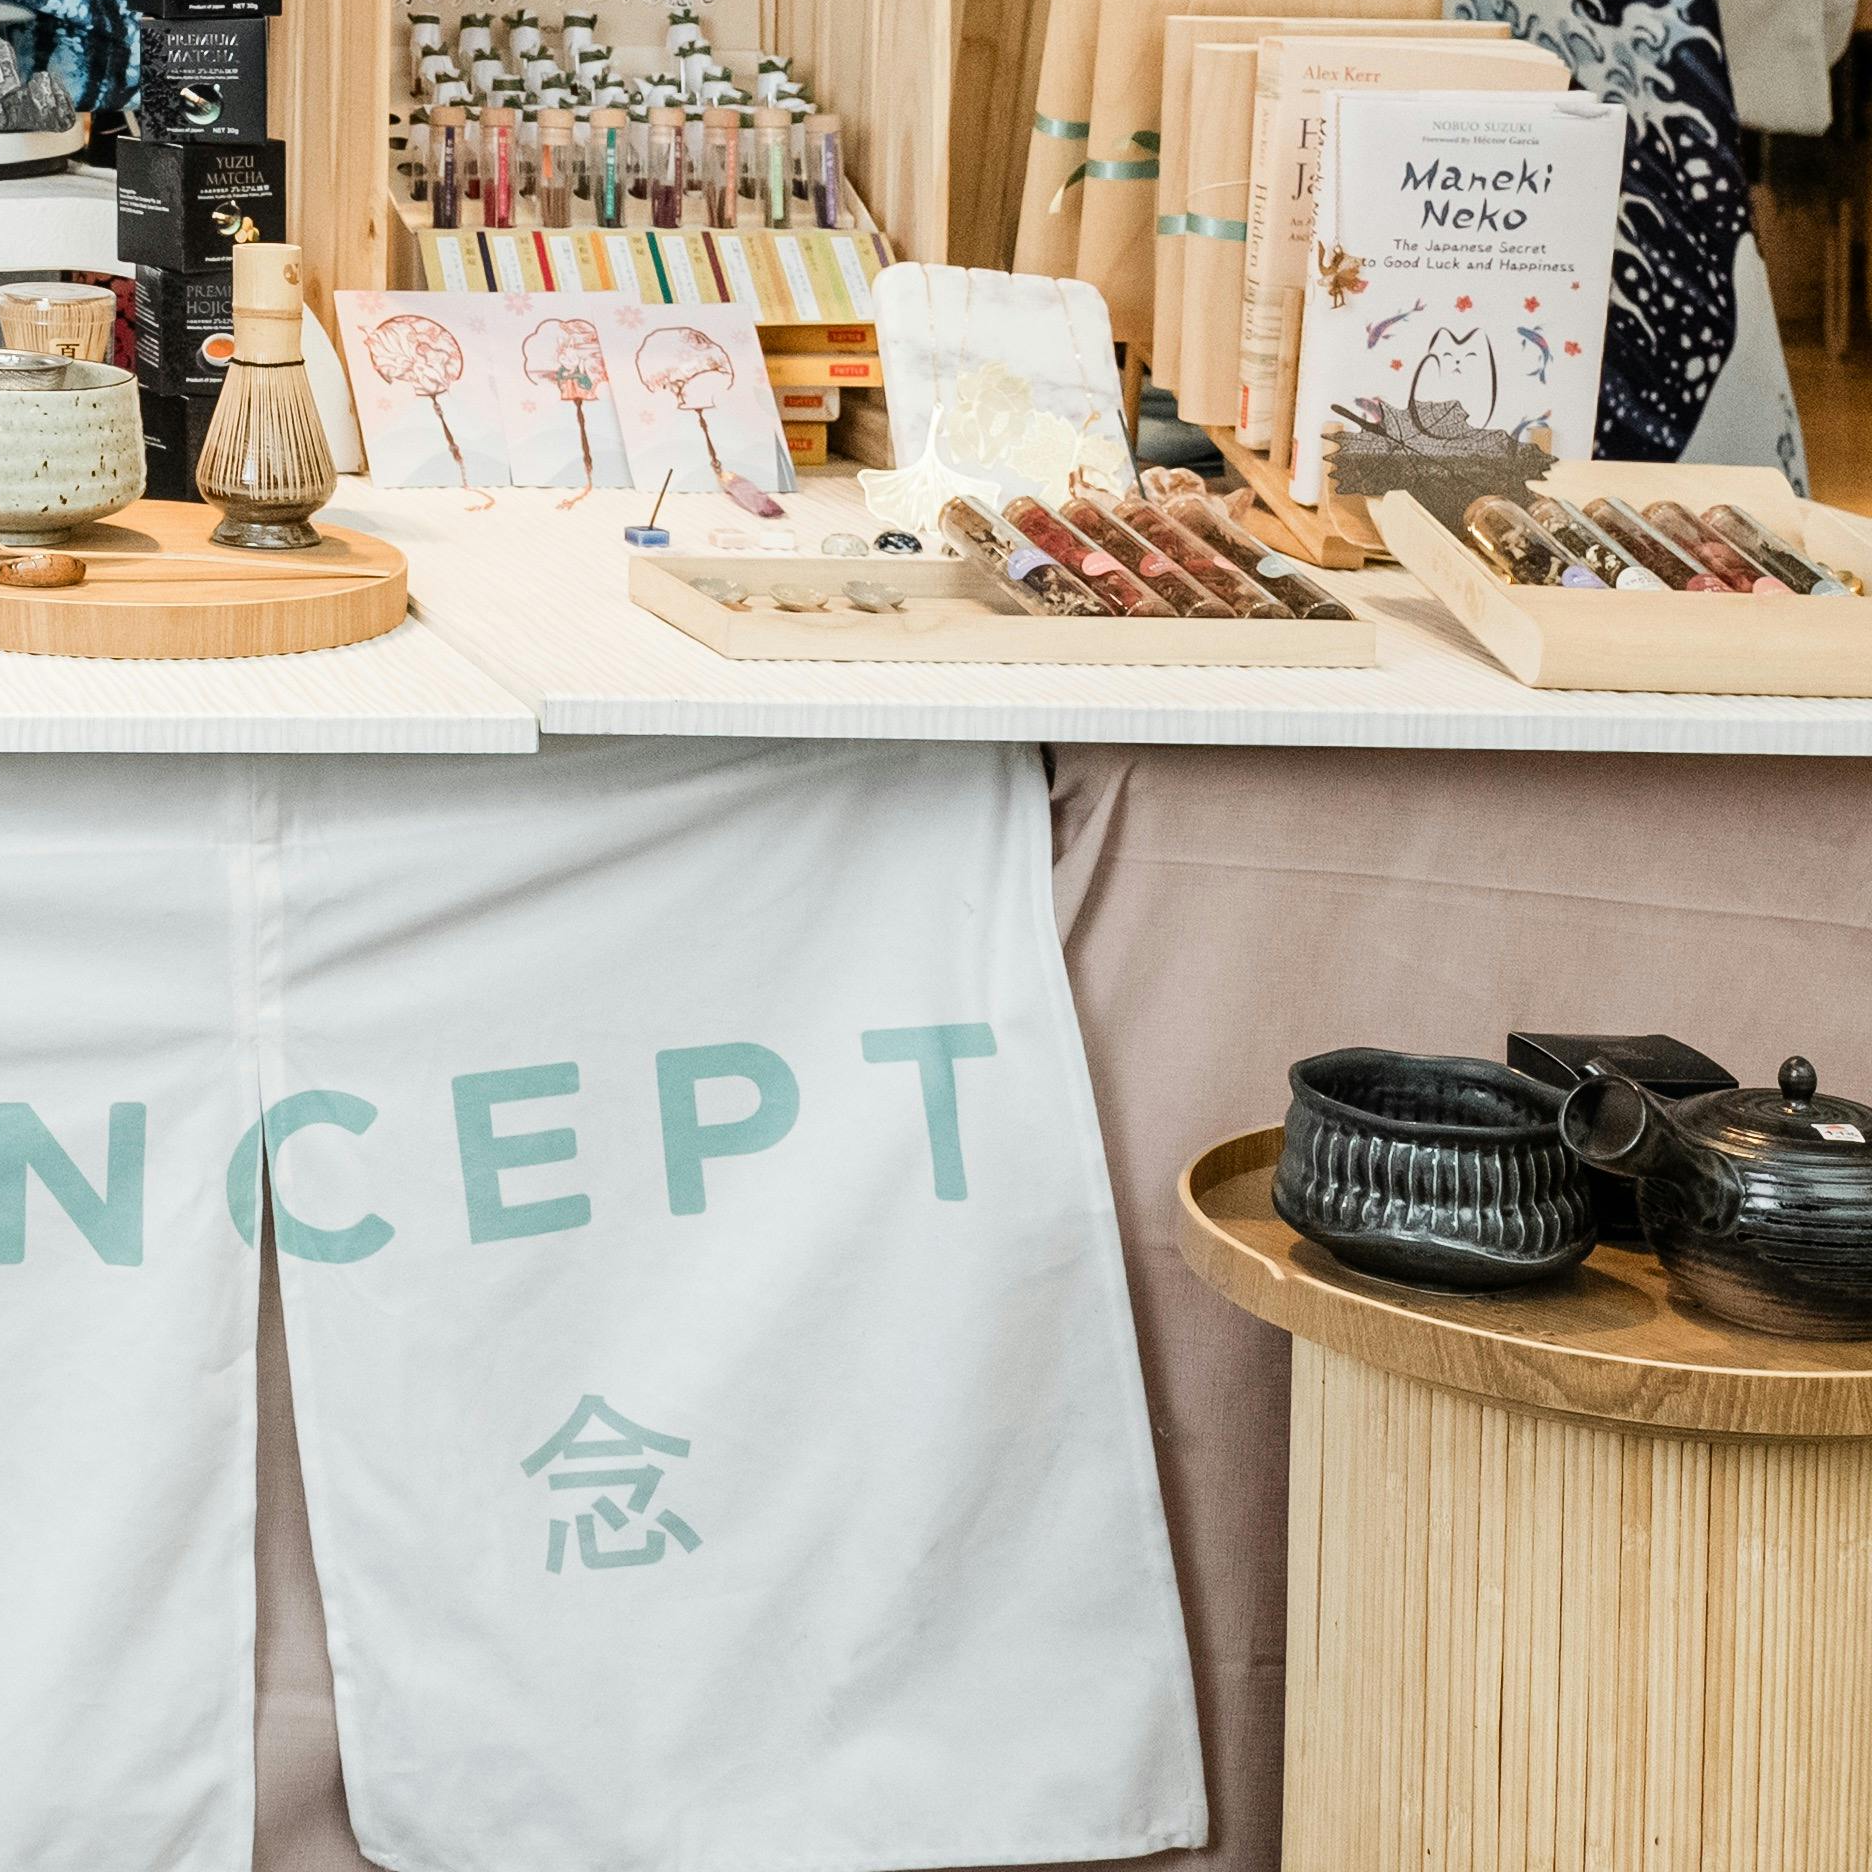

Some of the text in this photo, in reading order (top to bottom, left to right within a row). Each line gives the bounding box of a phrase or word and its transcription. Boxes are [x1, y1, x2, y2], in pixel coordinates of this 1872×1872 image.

[167, 33, 239, 46] PREMIUM
[167, 49, 240, 63] MATCHA
[1304, 65, 1382, 83] Alex Kerr
[1432, 120, 1533, 133] NOBUO SUZUKI
[216, 155, 255, 170] YUZU
[206, 171, 265, 187] MATCHA
[1400, 157, 1553, 195] Maneki
[1420, 197, 1528, 233] Neko
[1250, 183, 1268, 268] Hidden
[1393, 239, 1547, 255] The Japanese Secret
[1361, 256, 1576, 273] to Good Luck and Happiness
[186, 301, 234, 318] HOJIC
[1244, 277, 1260, 341] Japan
